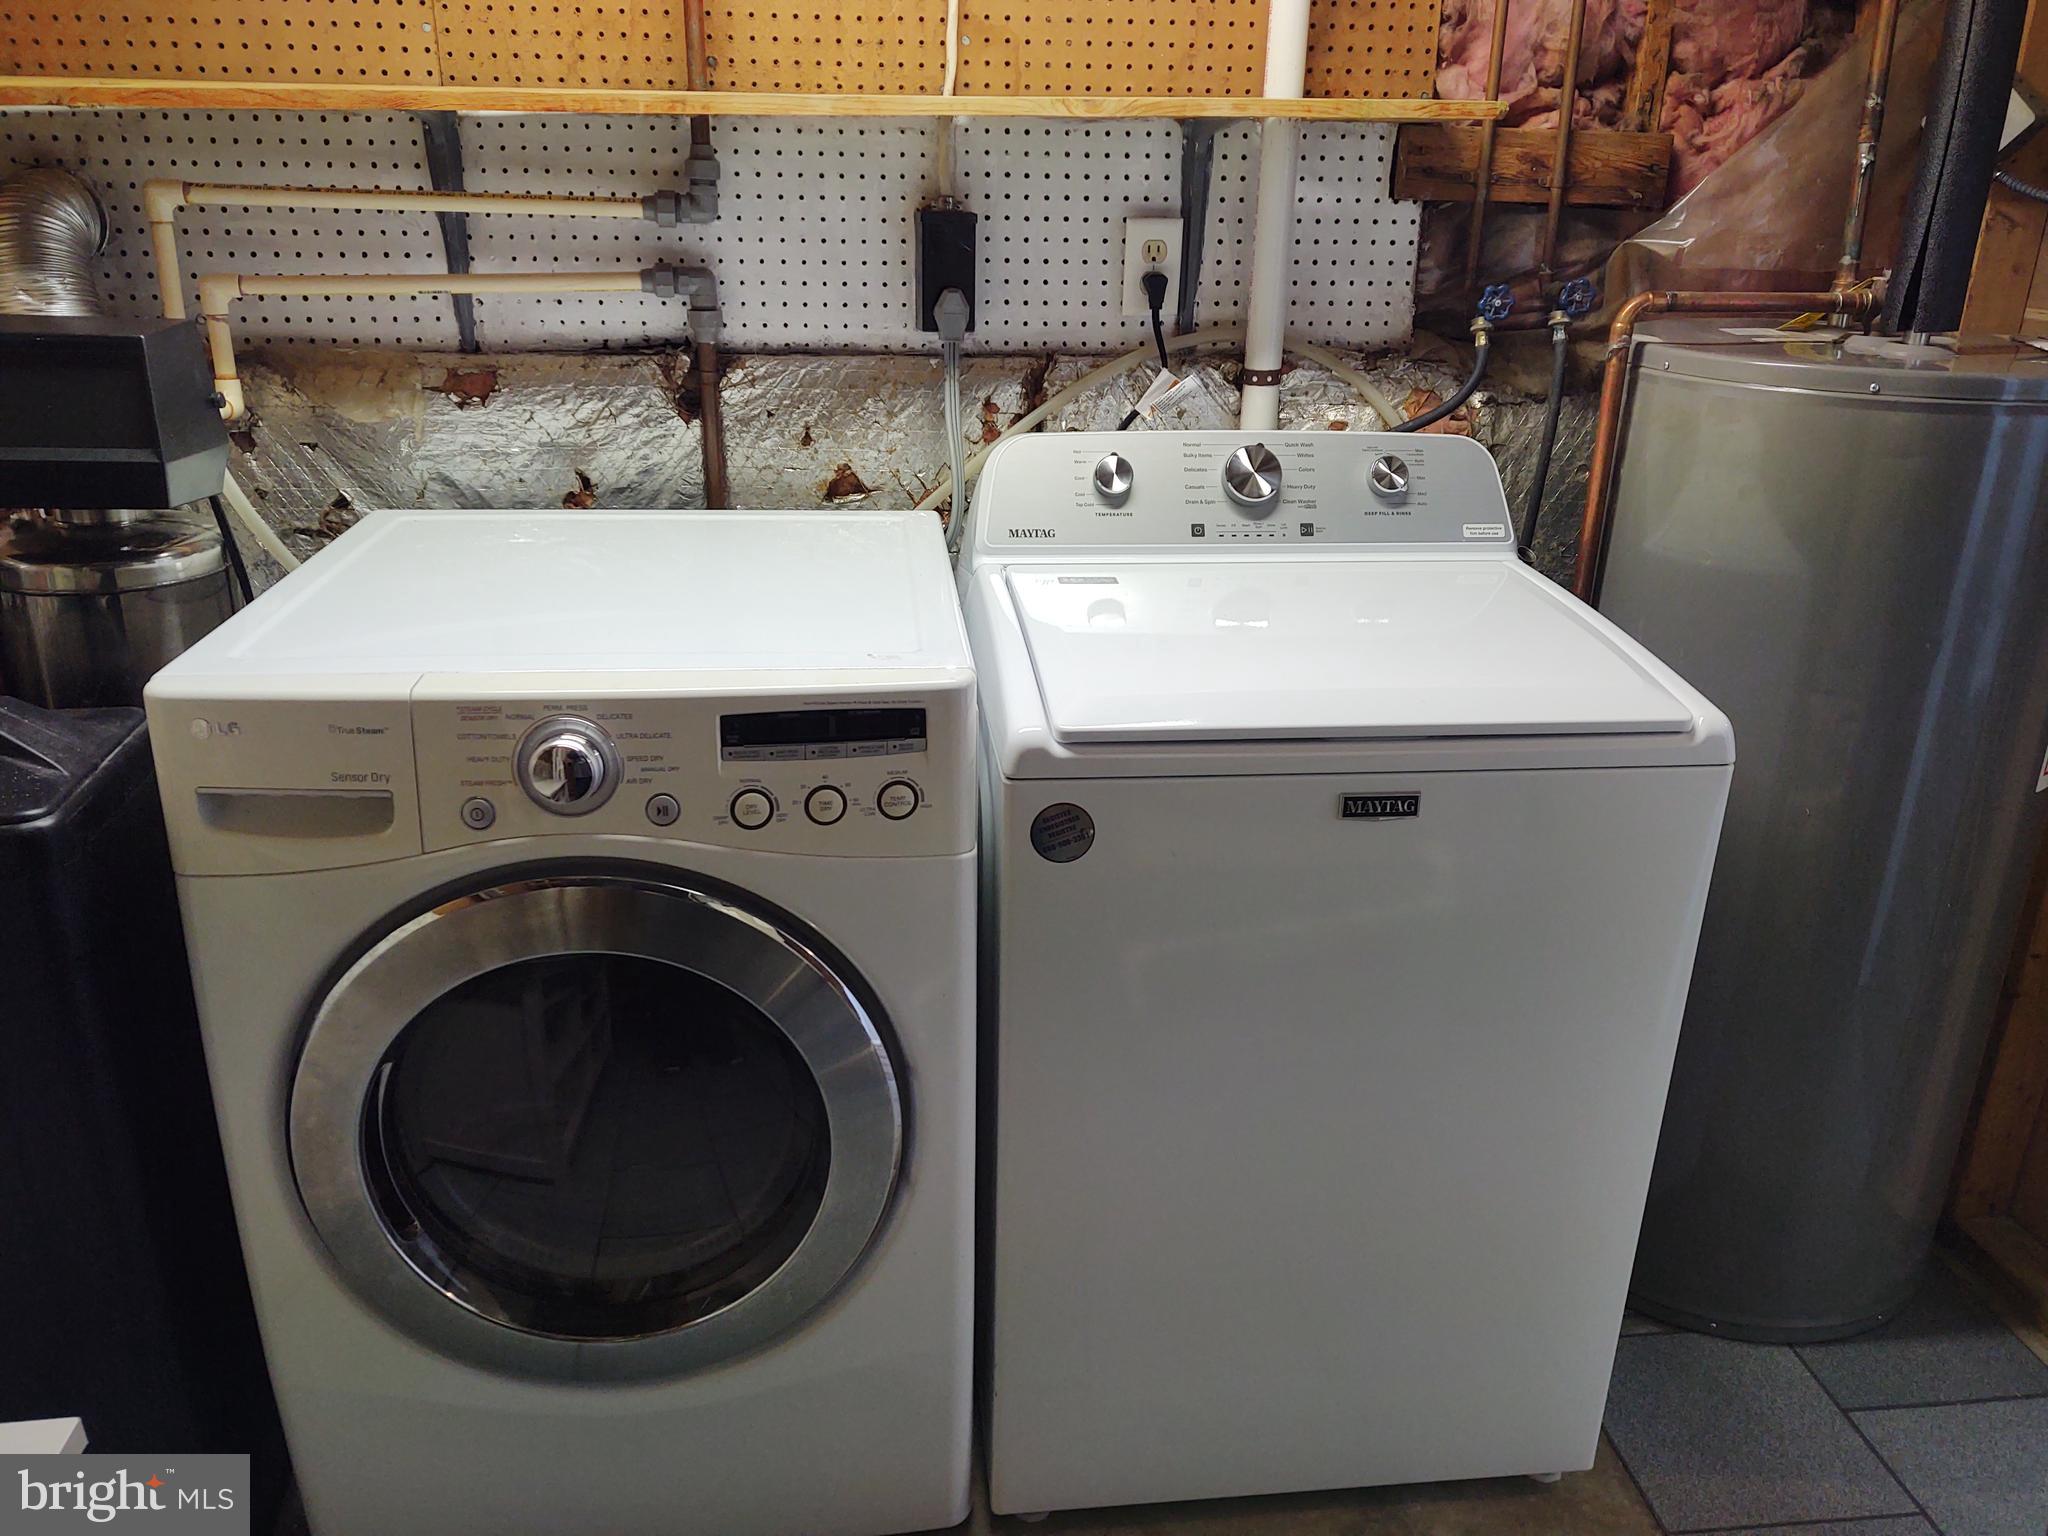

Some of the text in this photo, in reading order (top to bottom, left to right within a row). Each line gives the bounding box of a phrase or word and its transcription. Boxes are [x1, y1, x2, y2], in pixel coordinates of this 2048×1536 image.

[1008, 529, 1056, 538] MAYTAG
[214, 721, 241, 736] LG
[615, 732, 672, 740] ULTRA DELICATE
[330, 771, 392, 785] Sensor Dry
[639, 777, 654, 785] DRY
[883, 800, 912, 808] CONTROL
[1345, 799, 1415, 814] MAYTAG
